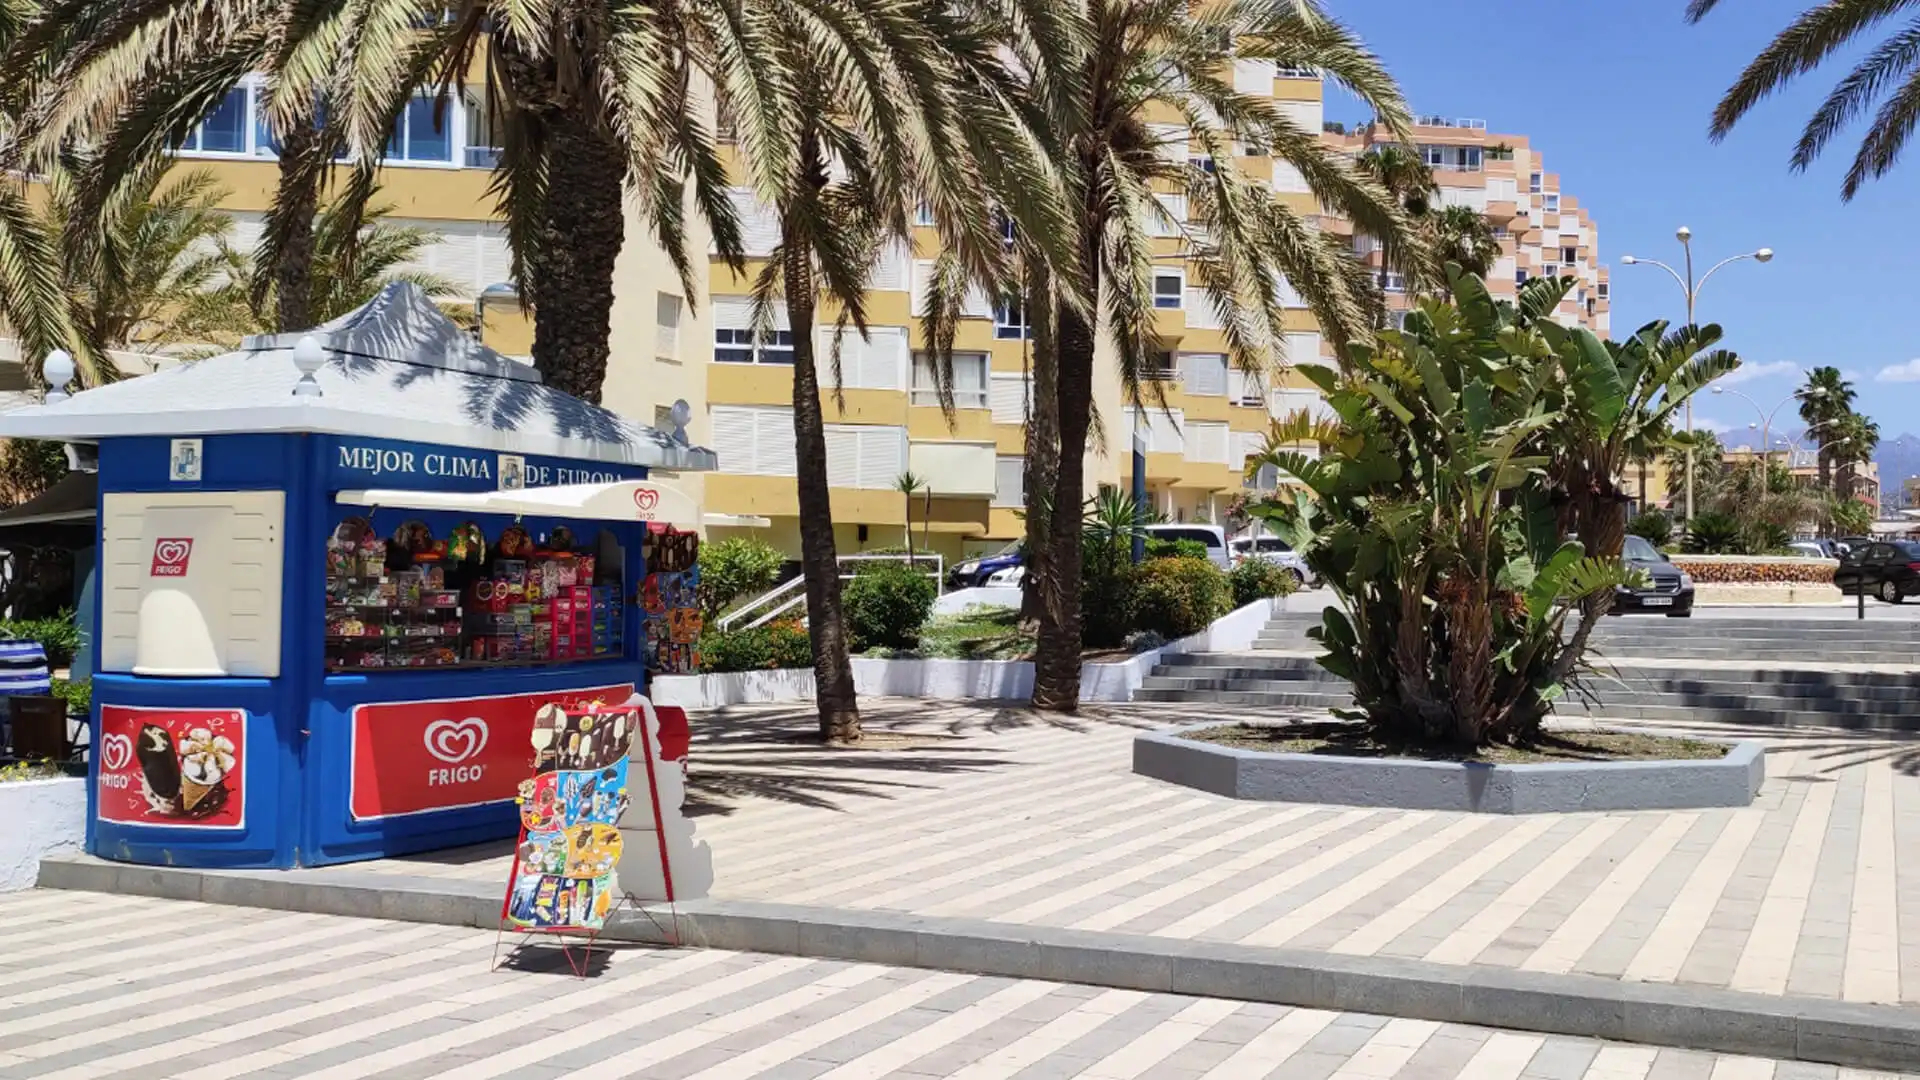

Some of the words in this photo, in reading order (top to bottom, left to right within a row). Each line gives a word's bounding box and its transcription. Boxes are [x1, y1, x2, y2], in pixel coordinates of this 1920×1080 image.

[338, 446, 415, 475] MEJOR
[424, 454, 491, 479] CLIMA
[526, 464, 550, 485] DE
[428, 765, 482, 787] FRIGO
